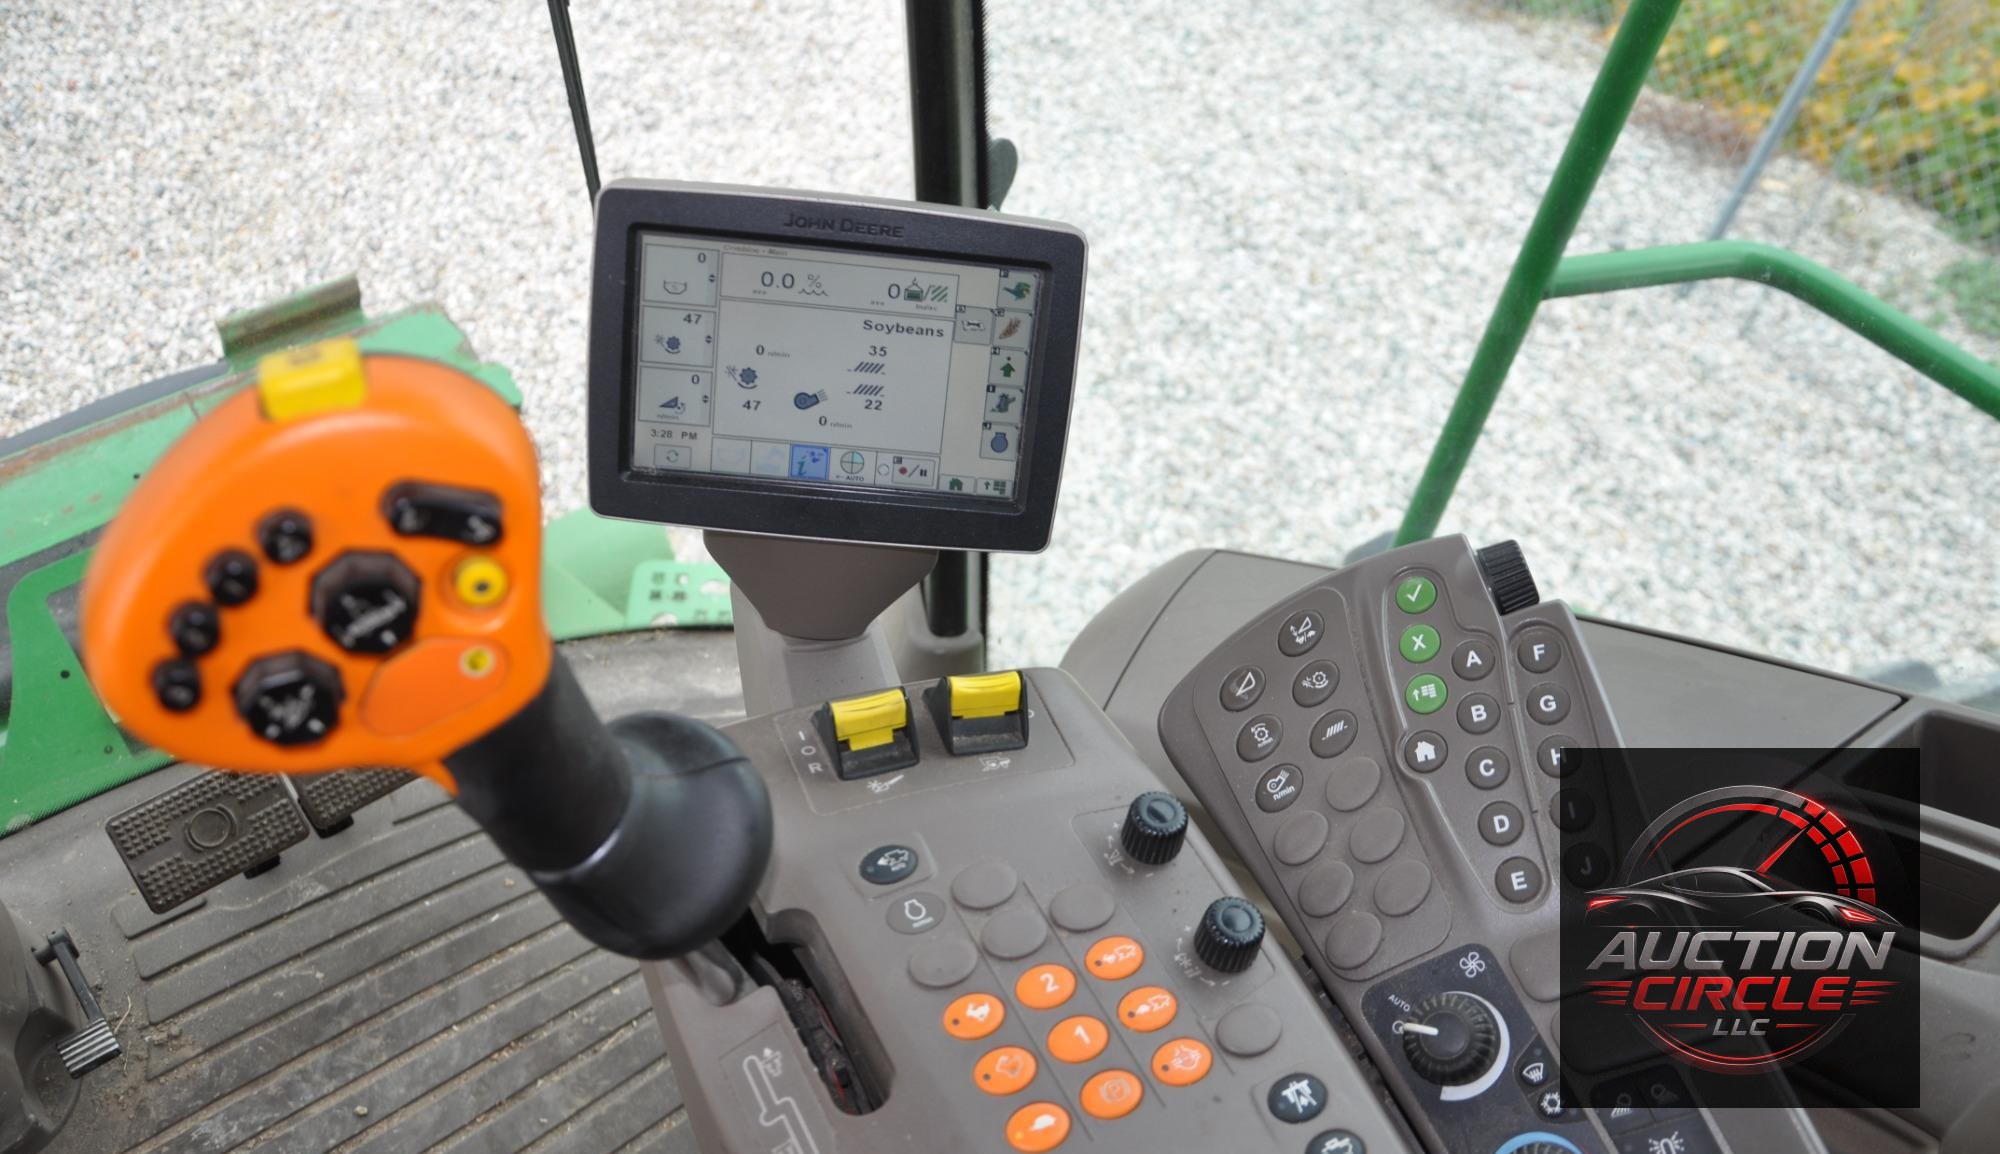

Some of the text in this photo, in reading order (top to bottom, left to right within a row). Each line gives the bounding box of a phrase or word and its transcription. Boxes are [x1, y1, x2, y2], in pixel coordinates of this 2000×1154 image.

[783, 213, 905, 238] JOHN DEERE
[697, 252, 707, 264] 0
[760, 271, 796, 290] 0.0
[887, 283, 901, 300] 0
[683, 313, 702, 325] 47
[862, 319, 945, 338] Soybeans
[755, 344, 765, 356] 0
[868, 344, 888, 358] 35
[691, 374, 701, 385] 0
[742, 400, 761, 412] 47
[864, 398, 883, 411] 22
[818, 415, 828, 426] 0
[650, 428, 698, 441] 3:28 PM
[1466, 650, 1483, 668] A
[1532, 643, 1546, 662] F
[1538, 695, 1557, 712] G
[1470, 704, 1487, 723] B
[1550, 746, 1567, 766] H
[808, 762, 823, 774] R
[1479, 758, 1496, 777] C
[1493, 814, 1510, 833] D
[1510, 871, 1528, 891] E
[1039, 972, 1060, 993] 2
[1387, 994, 1411, 1013] AUTO
[1074, 1025, 1091, 1045] 1
